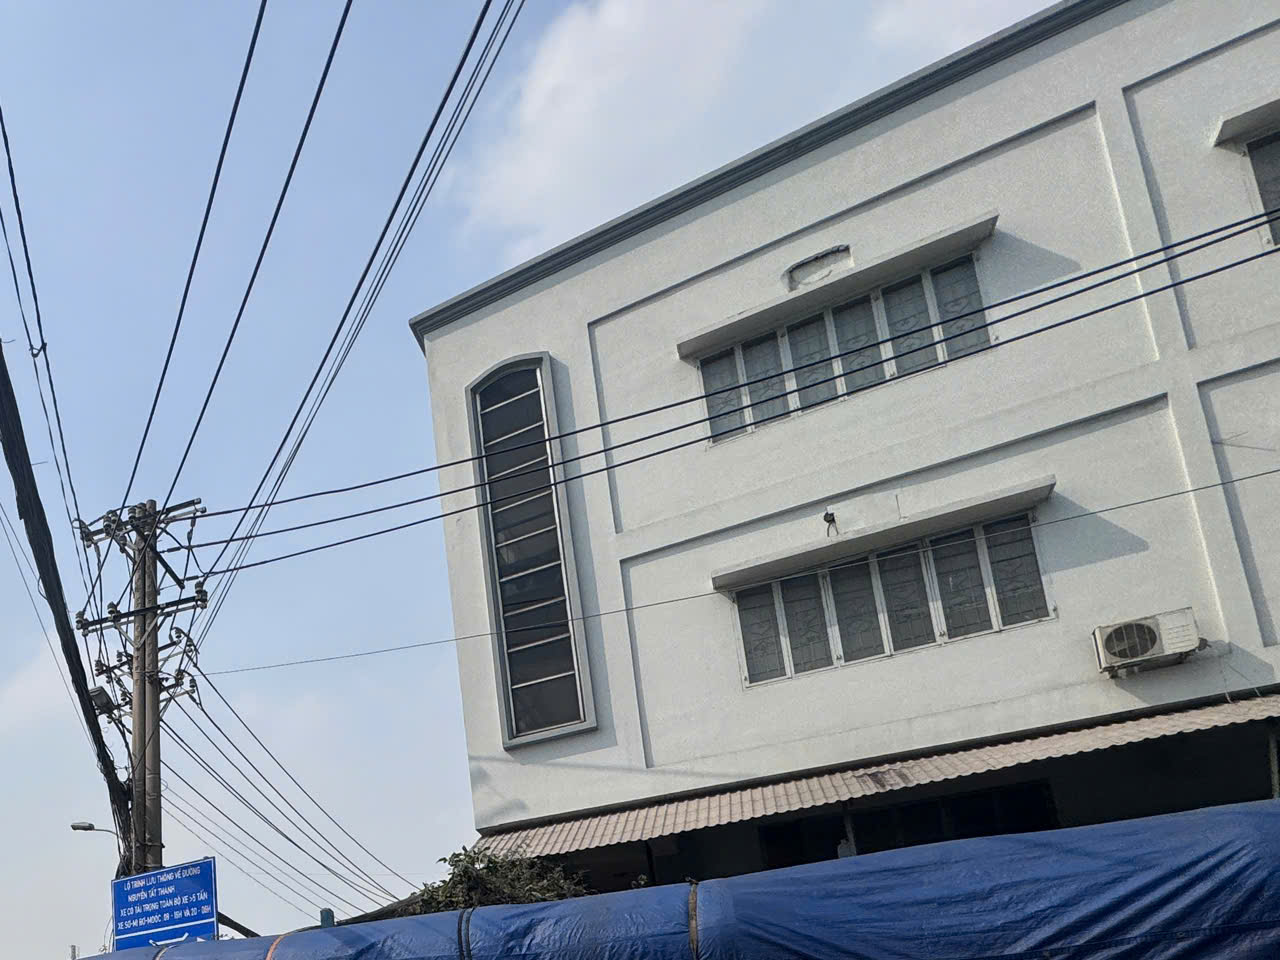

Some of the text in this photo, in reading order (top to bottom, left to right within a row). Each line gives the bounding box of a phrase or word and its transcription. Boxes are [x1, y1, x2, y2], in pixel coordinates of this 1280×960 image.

[120, 908, 127, 917] XE
[181, 895, 189, 905] XE
[197, 889, 208, 901] TẤN
[117, 920, 124, 930] XE
